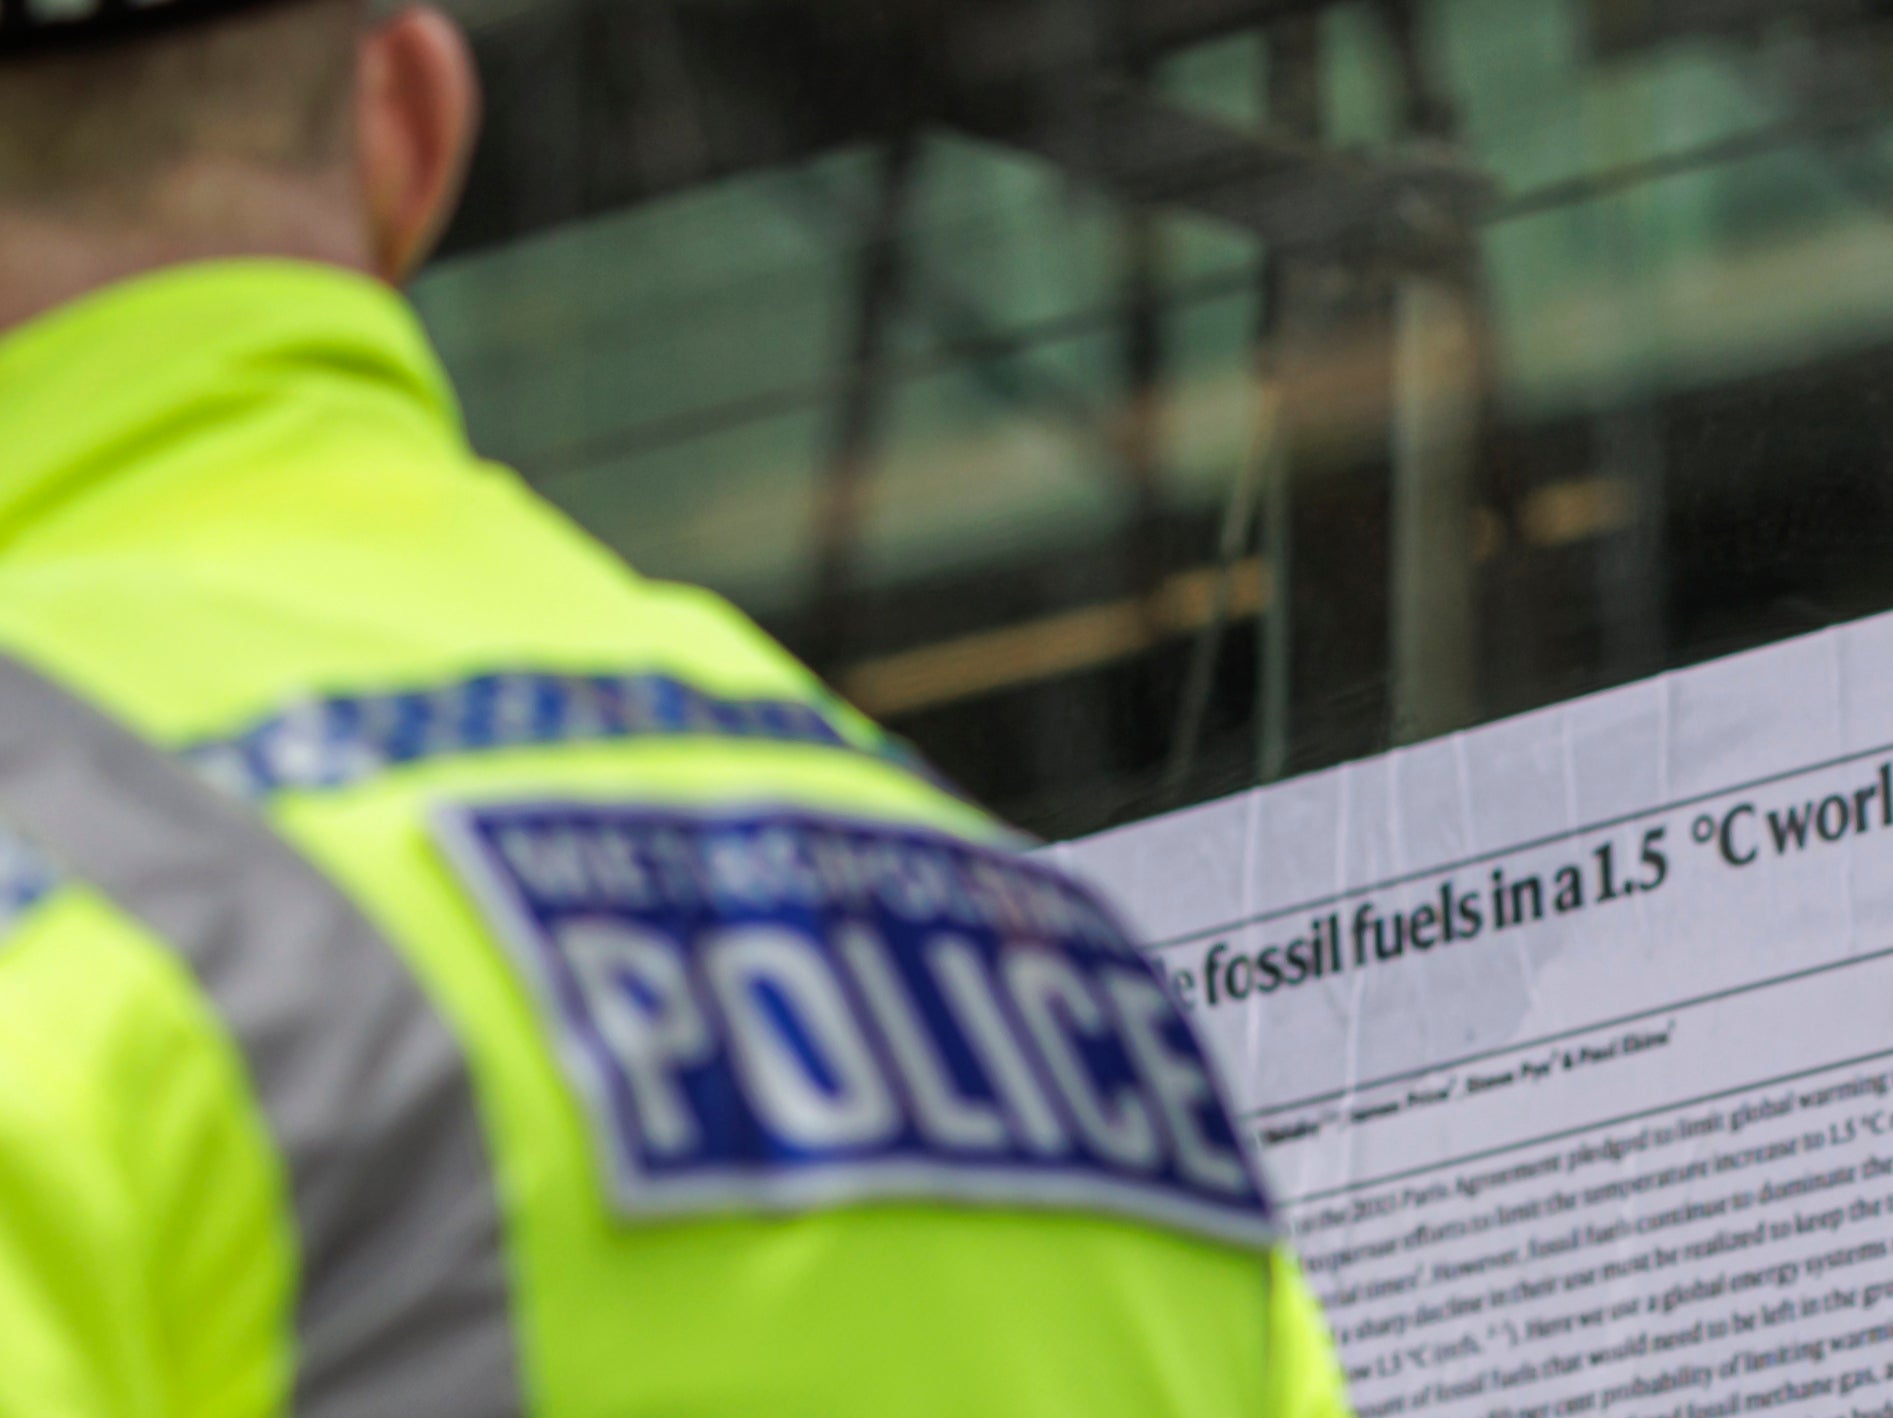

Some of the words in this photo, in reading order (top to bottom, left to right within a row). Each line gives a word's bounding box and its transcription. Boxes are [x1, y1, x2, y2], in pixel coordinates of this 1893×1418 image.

[1205, 914, 1342, 1005] fossil
[1352, 883, 1483, 965] fuels
[1492, 870, 1543, 930] in
[1554, 866, 1584, 913] a
[1595, 828, 1667, 902] 1.5
[1693, 804, 1756, 866] °C
[552, 912, 1250, 1194] POLICE
